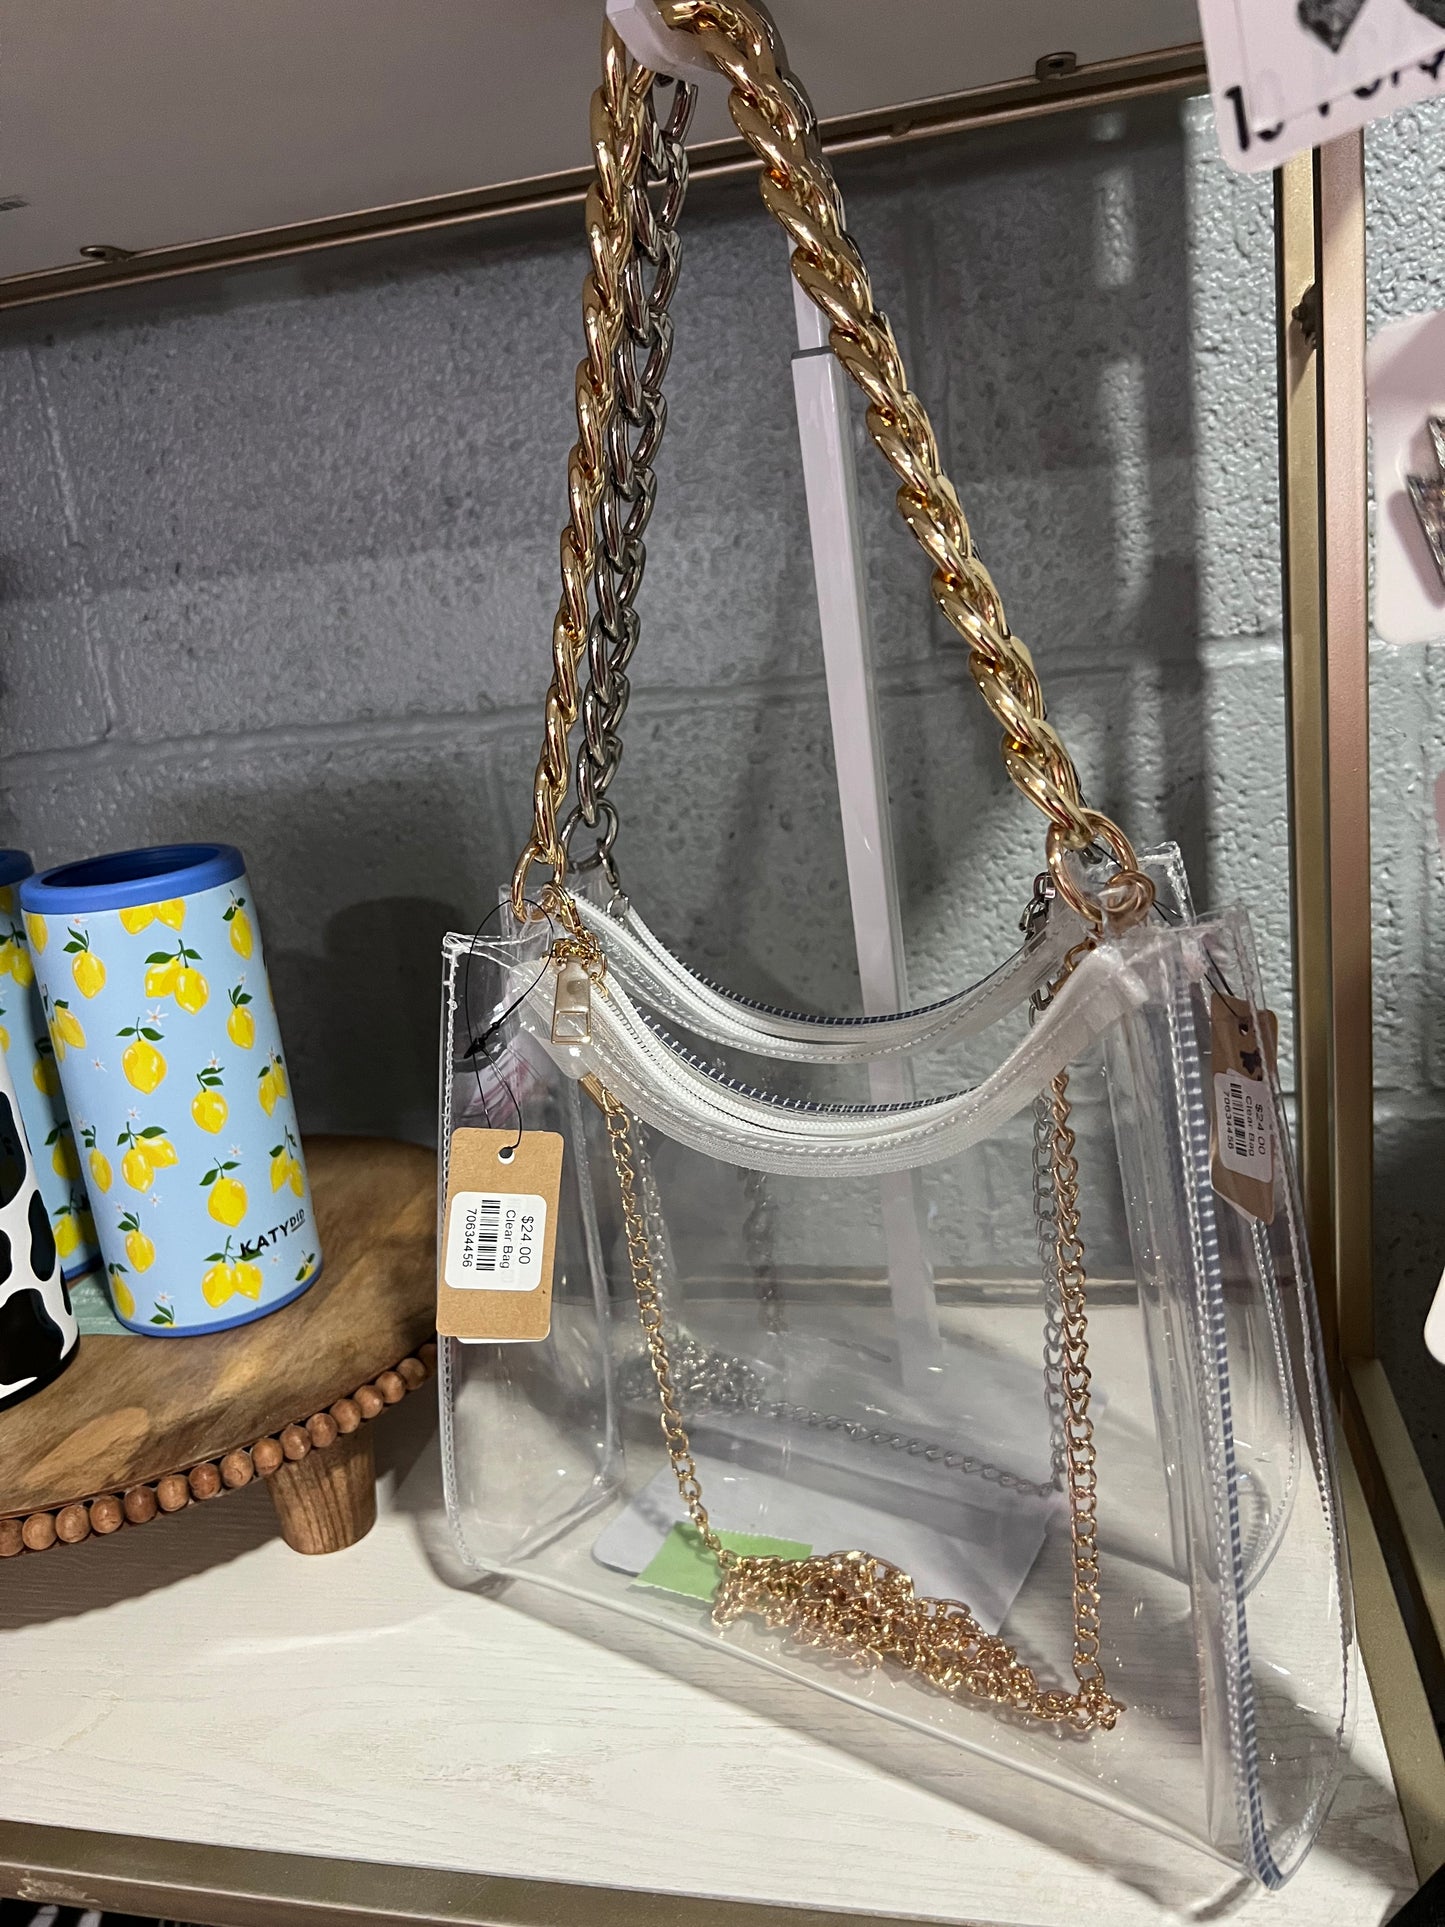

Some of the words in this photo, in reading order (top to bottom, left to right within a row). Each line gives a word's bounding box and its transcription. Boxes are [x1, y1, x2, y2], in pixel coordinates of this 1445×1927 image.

[1255, 1103, 1266, 1155] $2400
[240, 1208, 305, 1257] KATYDID
[462, 1208, 478, 1268] 70634456
[504, 1209, 517, 1242] Clear
[518, 1215, 535, 1265] $24.00
[499, 1245, 514, 1269] Bag
